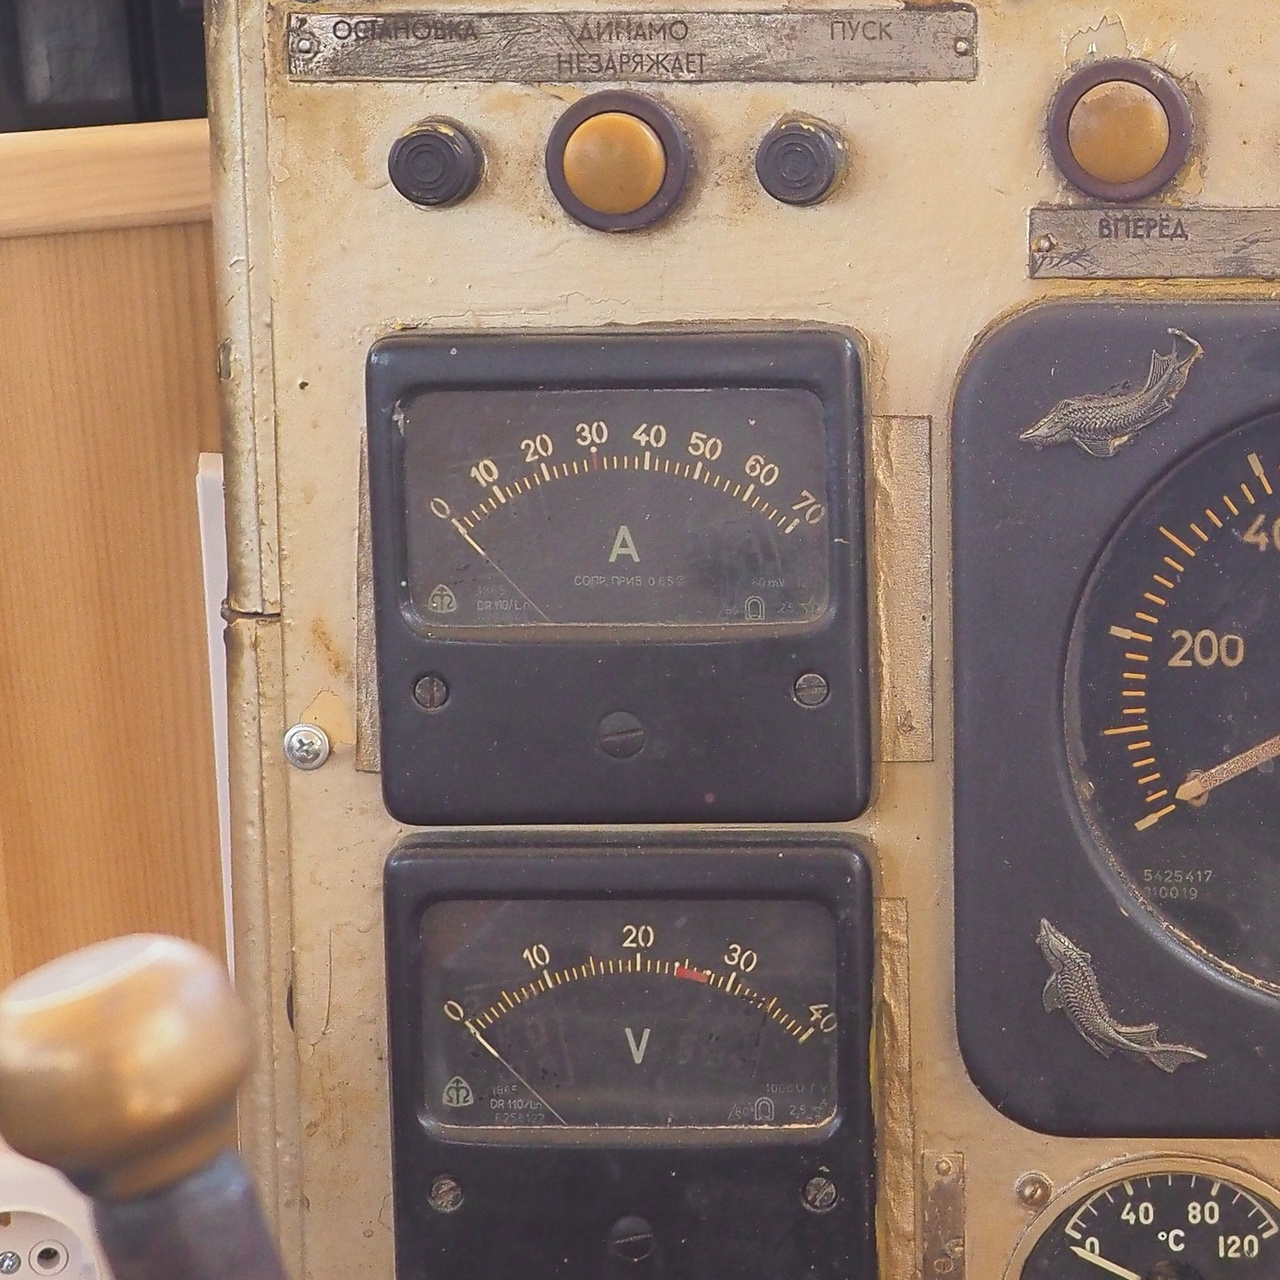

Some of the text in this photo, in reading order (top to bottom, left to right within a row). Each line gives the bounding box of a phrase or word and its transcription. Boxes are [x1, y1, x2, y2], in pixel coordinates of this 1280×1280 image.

[576, 19, 689, 44] ДИНАМО
[830, 20, 893, 41] ПУСК
[575, 421, 608, 446] 30
[632, 423, 666, 448] 40
[688, 431, 723, 461] 50
[520, 433, 553, 463] 20
[470, 458, 501, 488] 10
[744, 454, 779, 486] 60
[429, 497, 453, 519] 0
[792, 490, 826, 525] 70
[608, 525, 640, 562] A
[1167, 630, 1245, 667] 200
[622, 925, 655, 948] 20
[522, 943, 551, 969] 10
[724, 944, 758, 974] 30
[443, 1000, 465, 1022] 0
[808, 1002, 838, 1034] 40
[625, 1027, 651, 1064] V
[1121, 1202, 1154, 1225] 40
[1188, 1201, 1220, 1224] 80
[1218, 1235, 1259, 1258] 120
